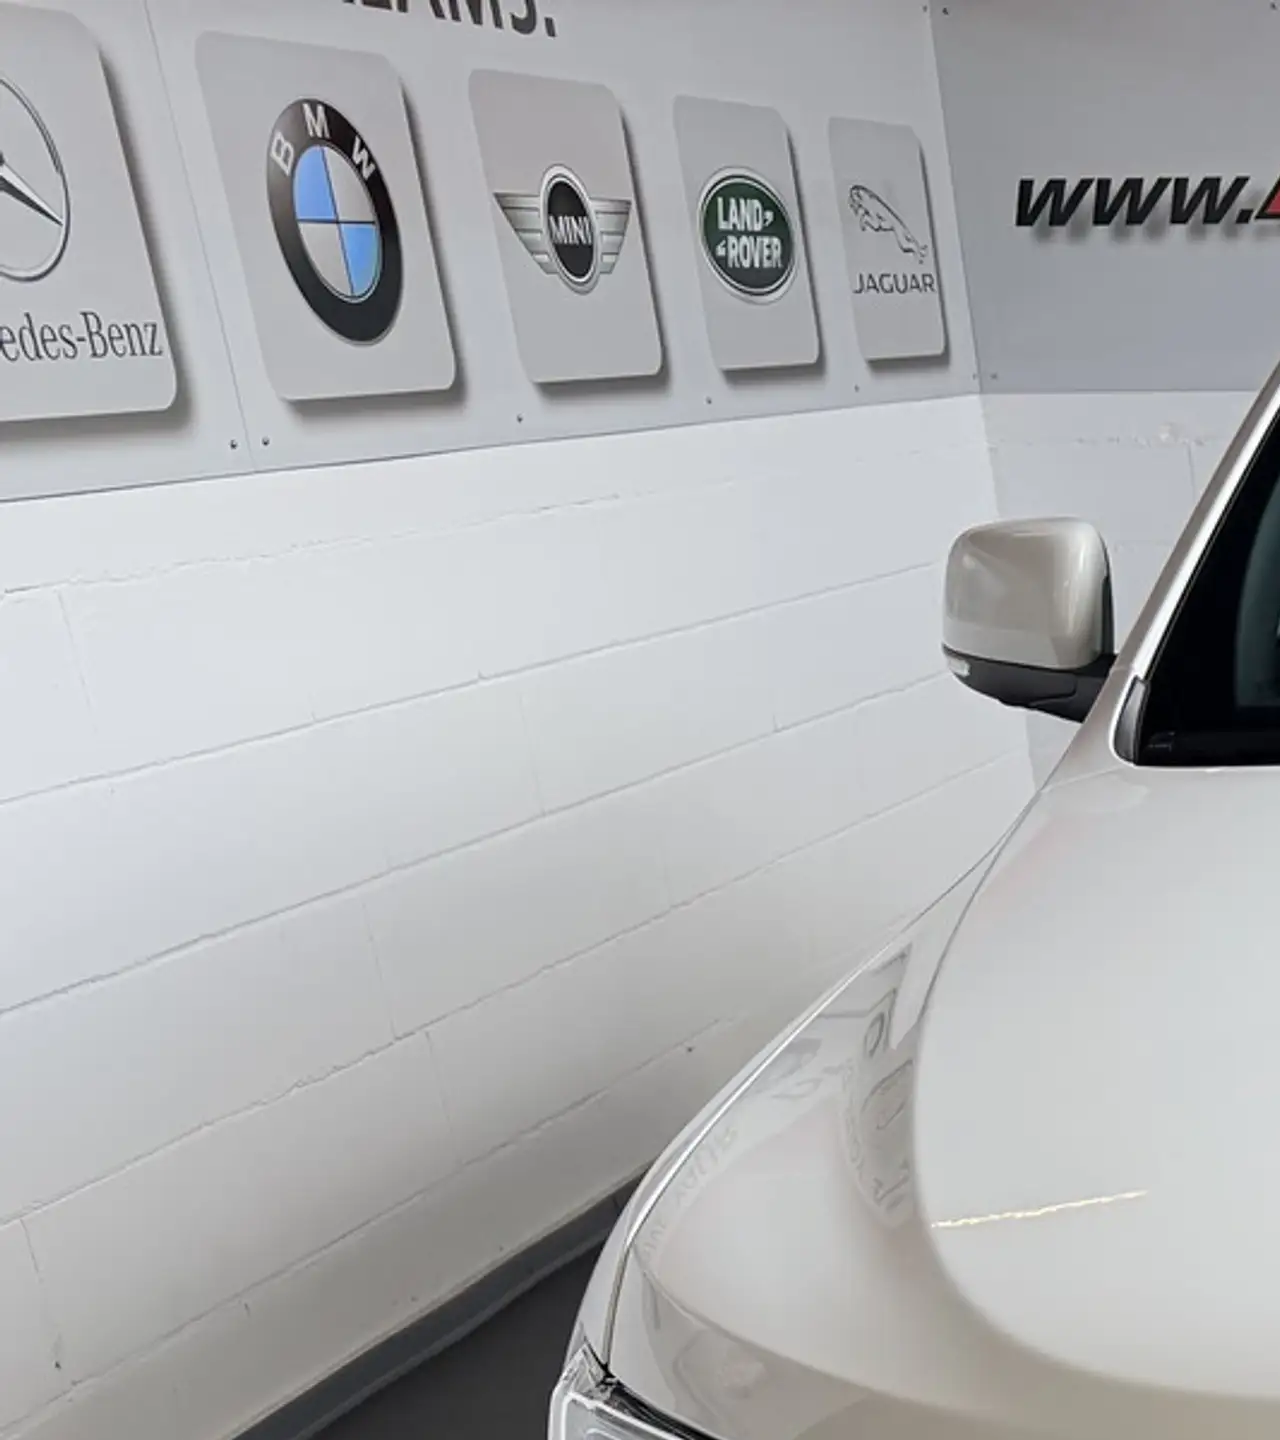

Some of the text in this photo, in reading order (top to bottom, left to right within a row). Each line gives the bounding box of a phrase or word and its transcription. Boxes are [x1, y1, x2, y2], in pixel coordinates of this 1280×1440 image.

[271, 103, 377, 176] BMW
[549, 214, 594, 246] MINI
[853, 272, 936, 294] JAGUAR
